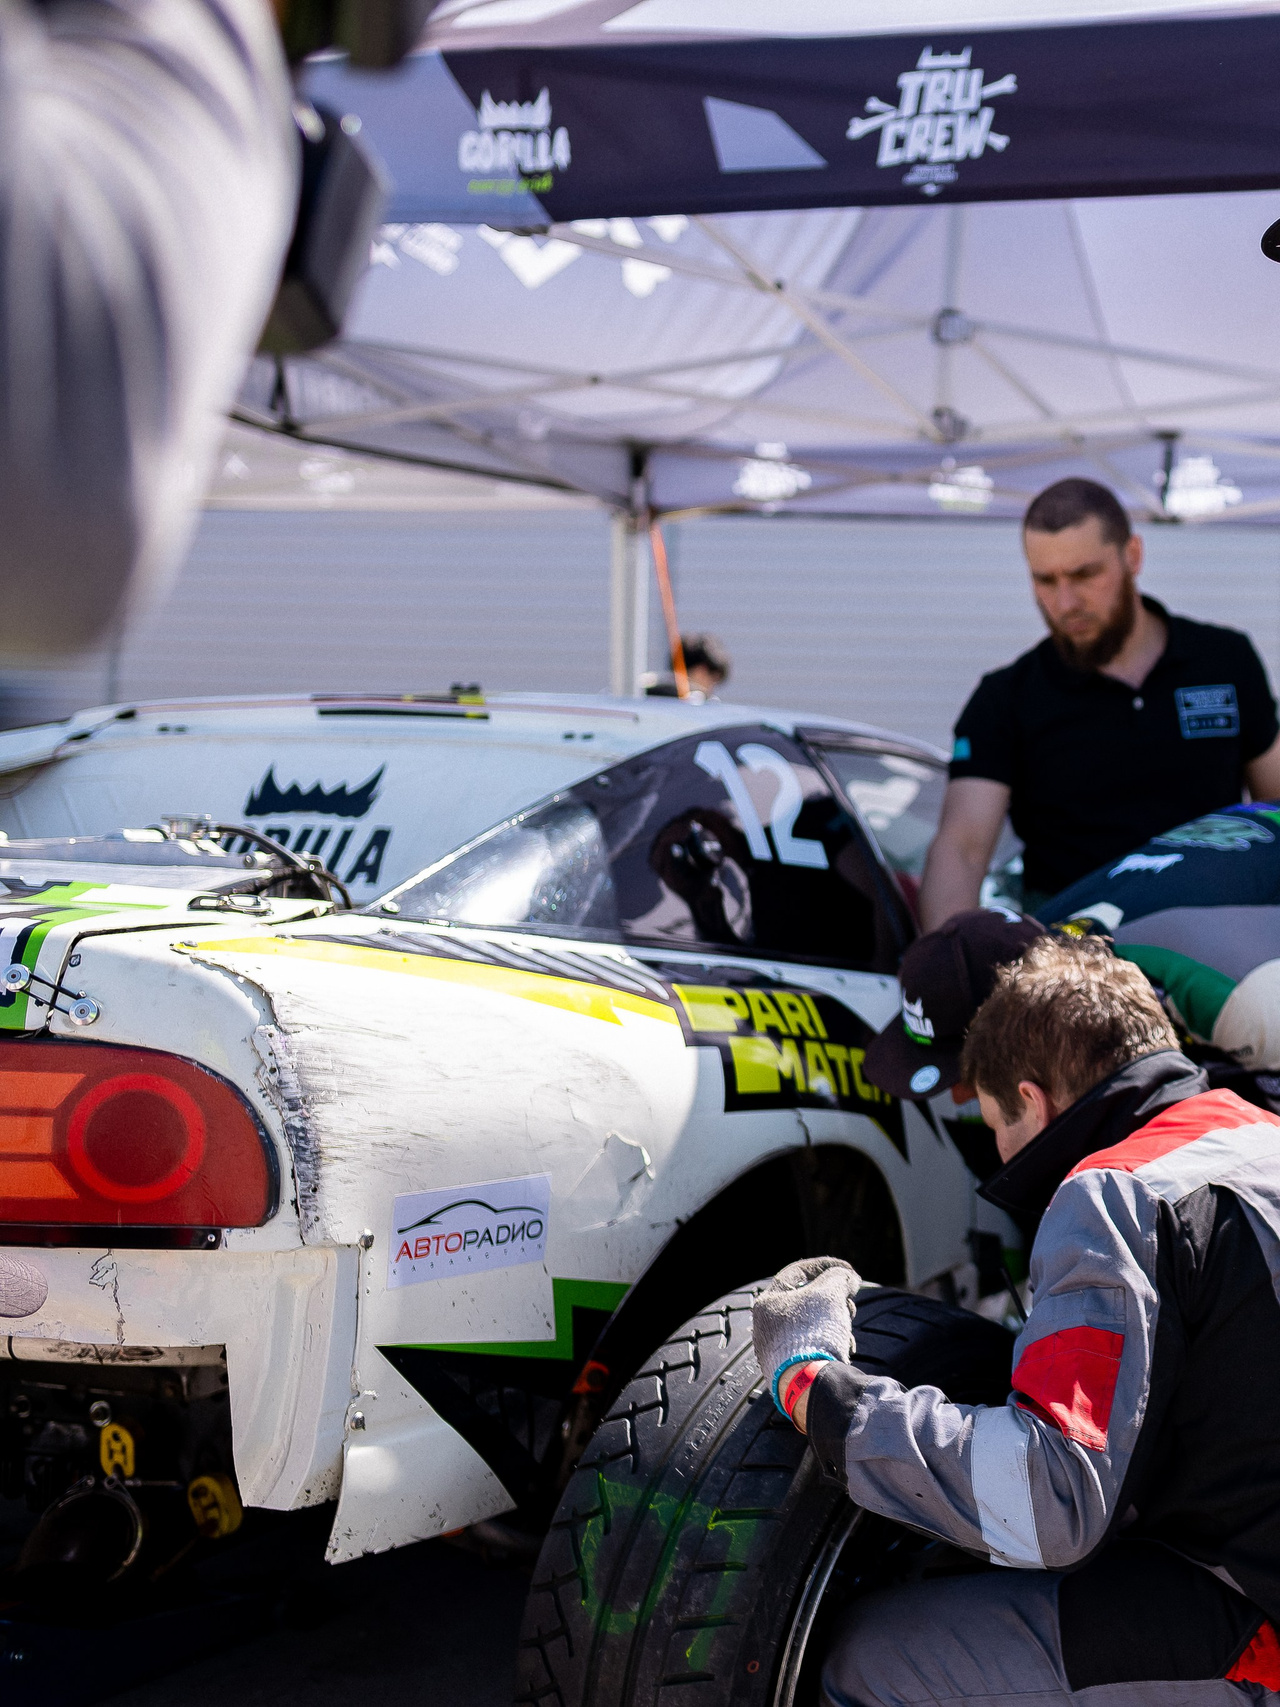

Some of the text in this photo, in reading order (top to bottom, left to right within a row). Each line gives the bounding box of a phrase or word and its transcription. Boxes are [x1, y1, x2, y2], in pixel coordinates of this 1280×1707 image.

[896, 68, 985, 118] TRU
[876, 106, 995, 169] CREW
[693, 740, 829, 870] 12
[672, 983, 828, 1040] PARI
[728, 1036, 892, 1105] MATC
[395, 1219, 543, 1263] АВТОРАДИО
